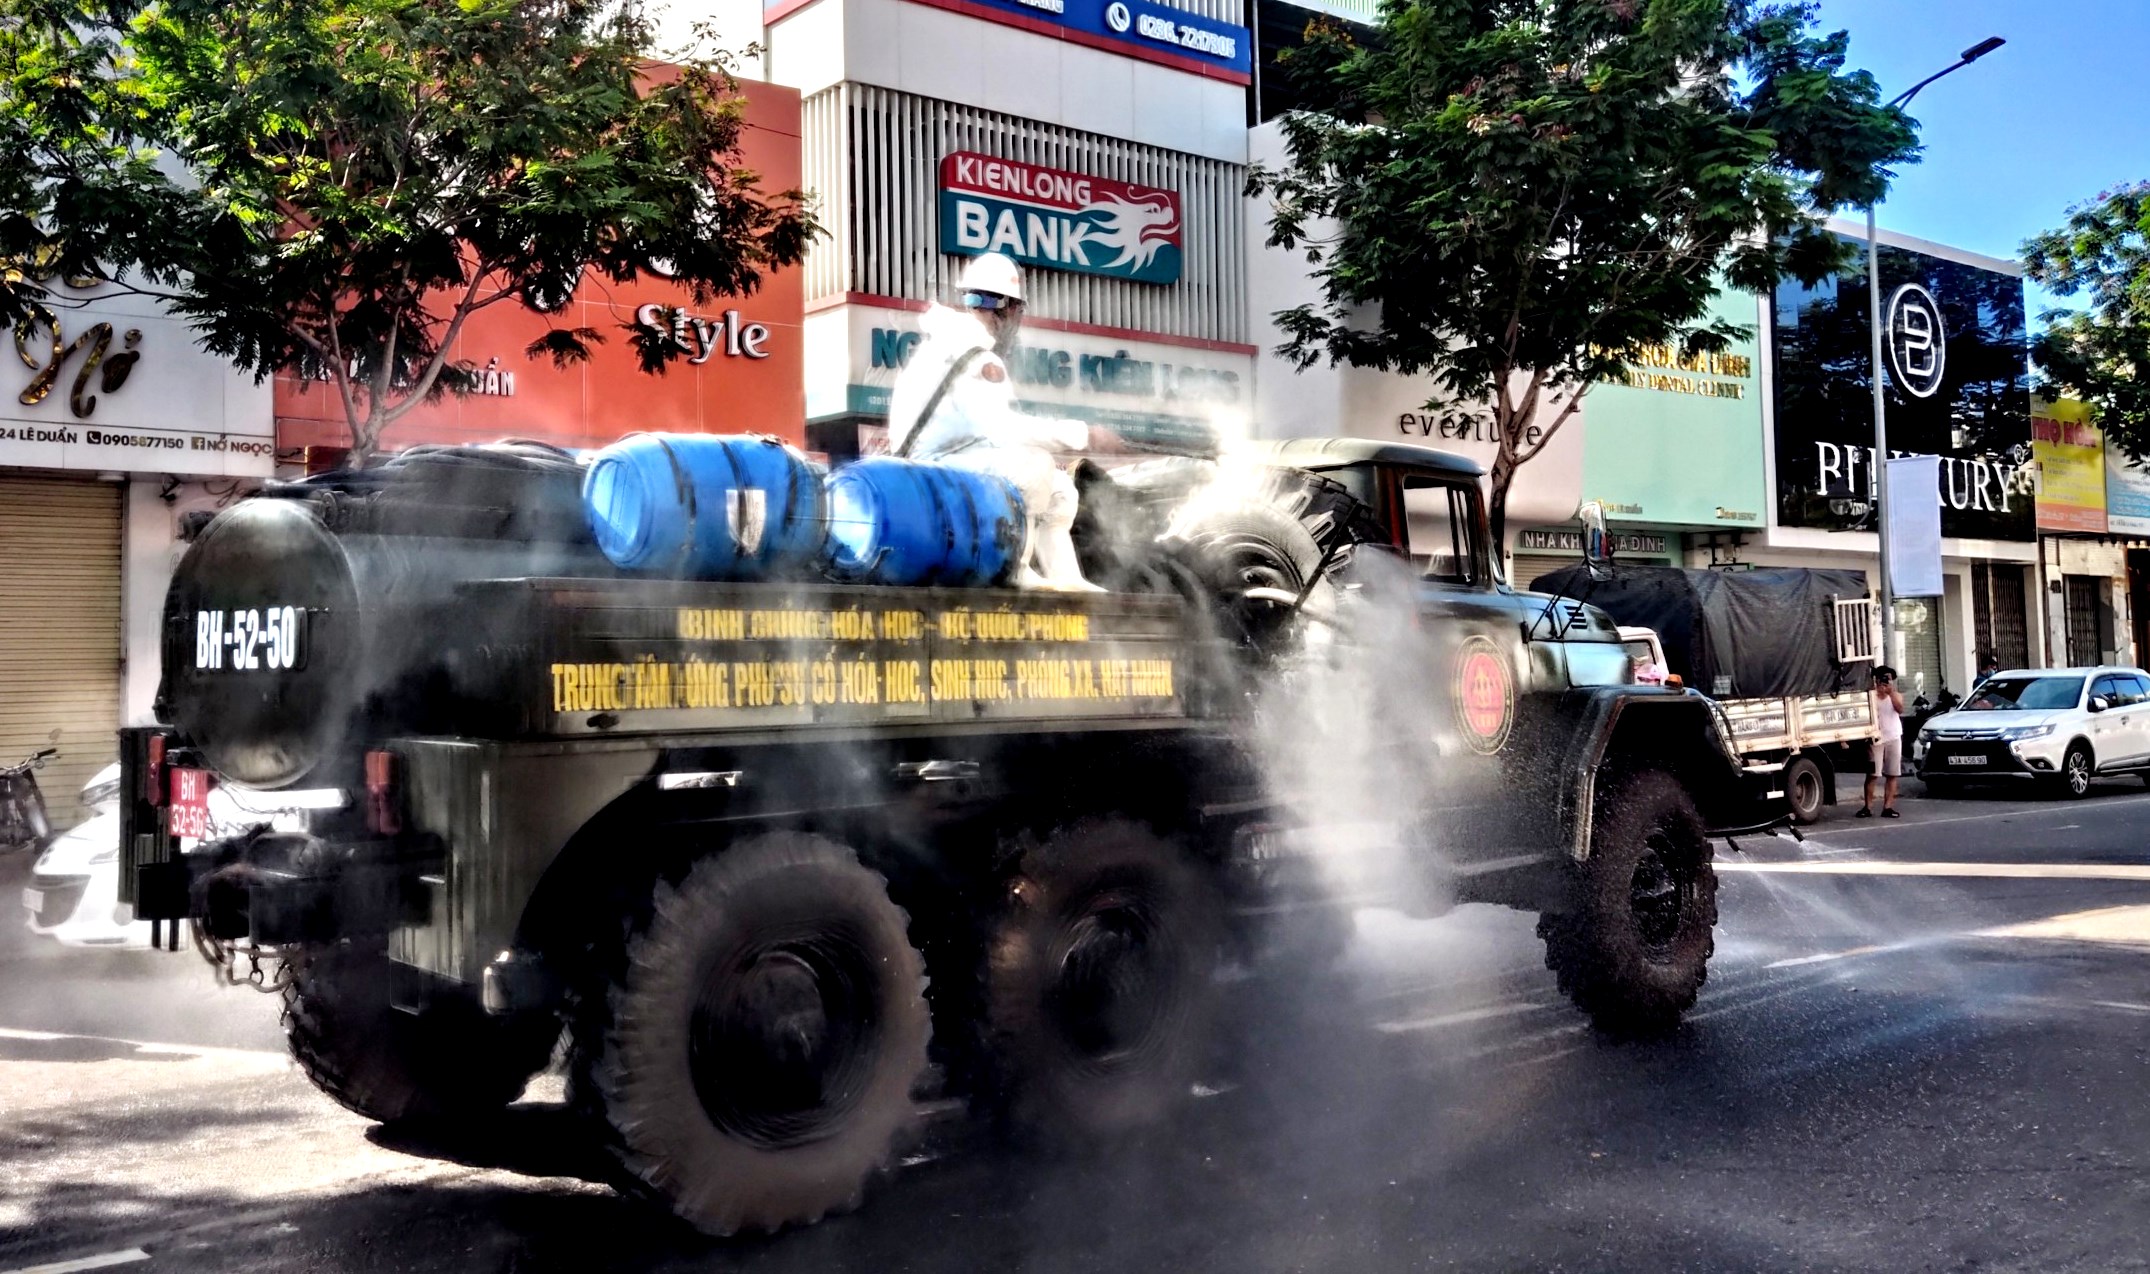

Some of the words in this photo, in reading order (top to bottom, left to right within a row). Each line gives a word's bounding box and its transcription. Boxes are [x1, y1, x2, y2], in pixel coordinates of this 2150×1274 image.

[955, 155, 1091, 205] KIENLONG
[956, 200, 1091, 266] BANK
[637, 304, 769, 363] Style
[19, 427, 35, 442] LÊ
[102, 434, 184, 449] 0905877150
[196, 605, 295, 670] BH-52-50
[682, 608, 744, 641] BINH
[832, 603, 875, 641] HÓA
[181, 771, 196, 801] BH
